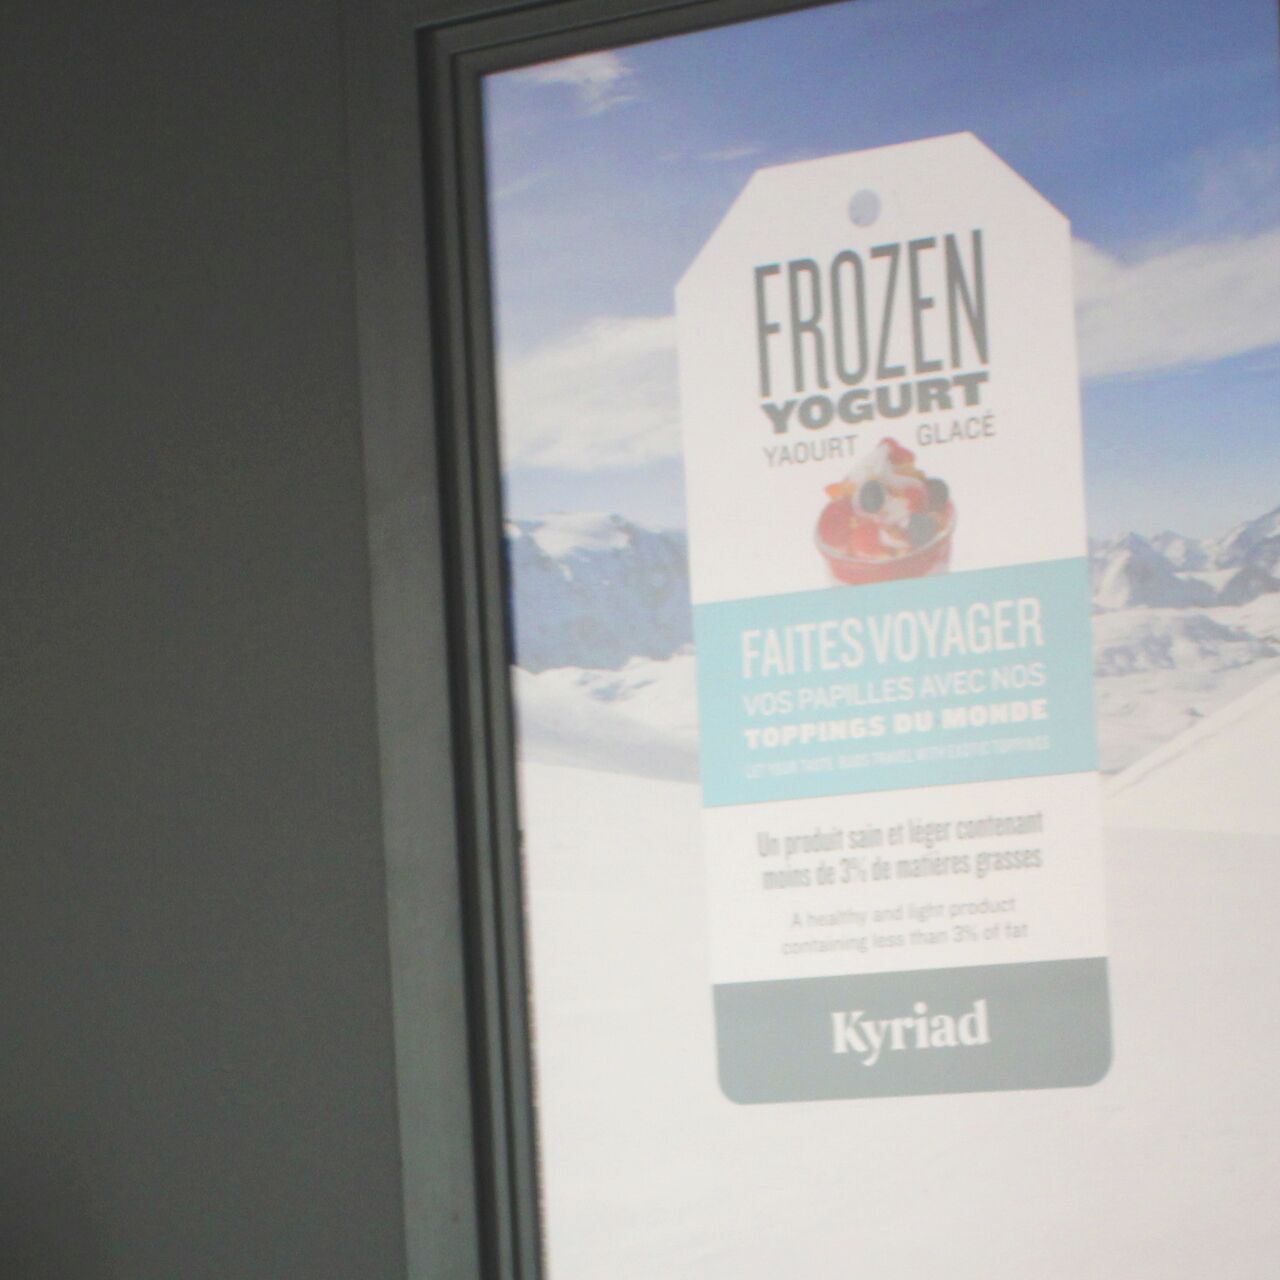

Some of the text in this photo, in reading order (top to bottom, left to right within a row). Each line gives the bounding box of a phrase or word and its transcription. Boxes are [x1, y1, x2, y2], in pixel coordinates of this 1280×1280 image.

[754, 229, 990, 398] FROZEN
[761, 371, 990, 435] YOGURT
[763, 408, 996, 468] YAOURT GLACÉ
[741, 597, 1045, 679] FAITES VOYAGER
[742, 662, 1048, 717] VOS PAPILLES AVEC NOS
[744, 698, 1049, 749] TOPPINGS DU MONDE
[756, 813, 1043, 860] Un produit sain et léger contenant
[763, 849, 1044, 889] moins de 3% de matières grasses
[781, 922, 1028, 956] containing less than 3% of fat
[790, 898, 1016, 927] A healthy and light product
[831, 998, 991, 1066] Kyriad
